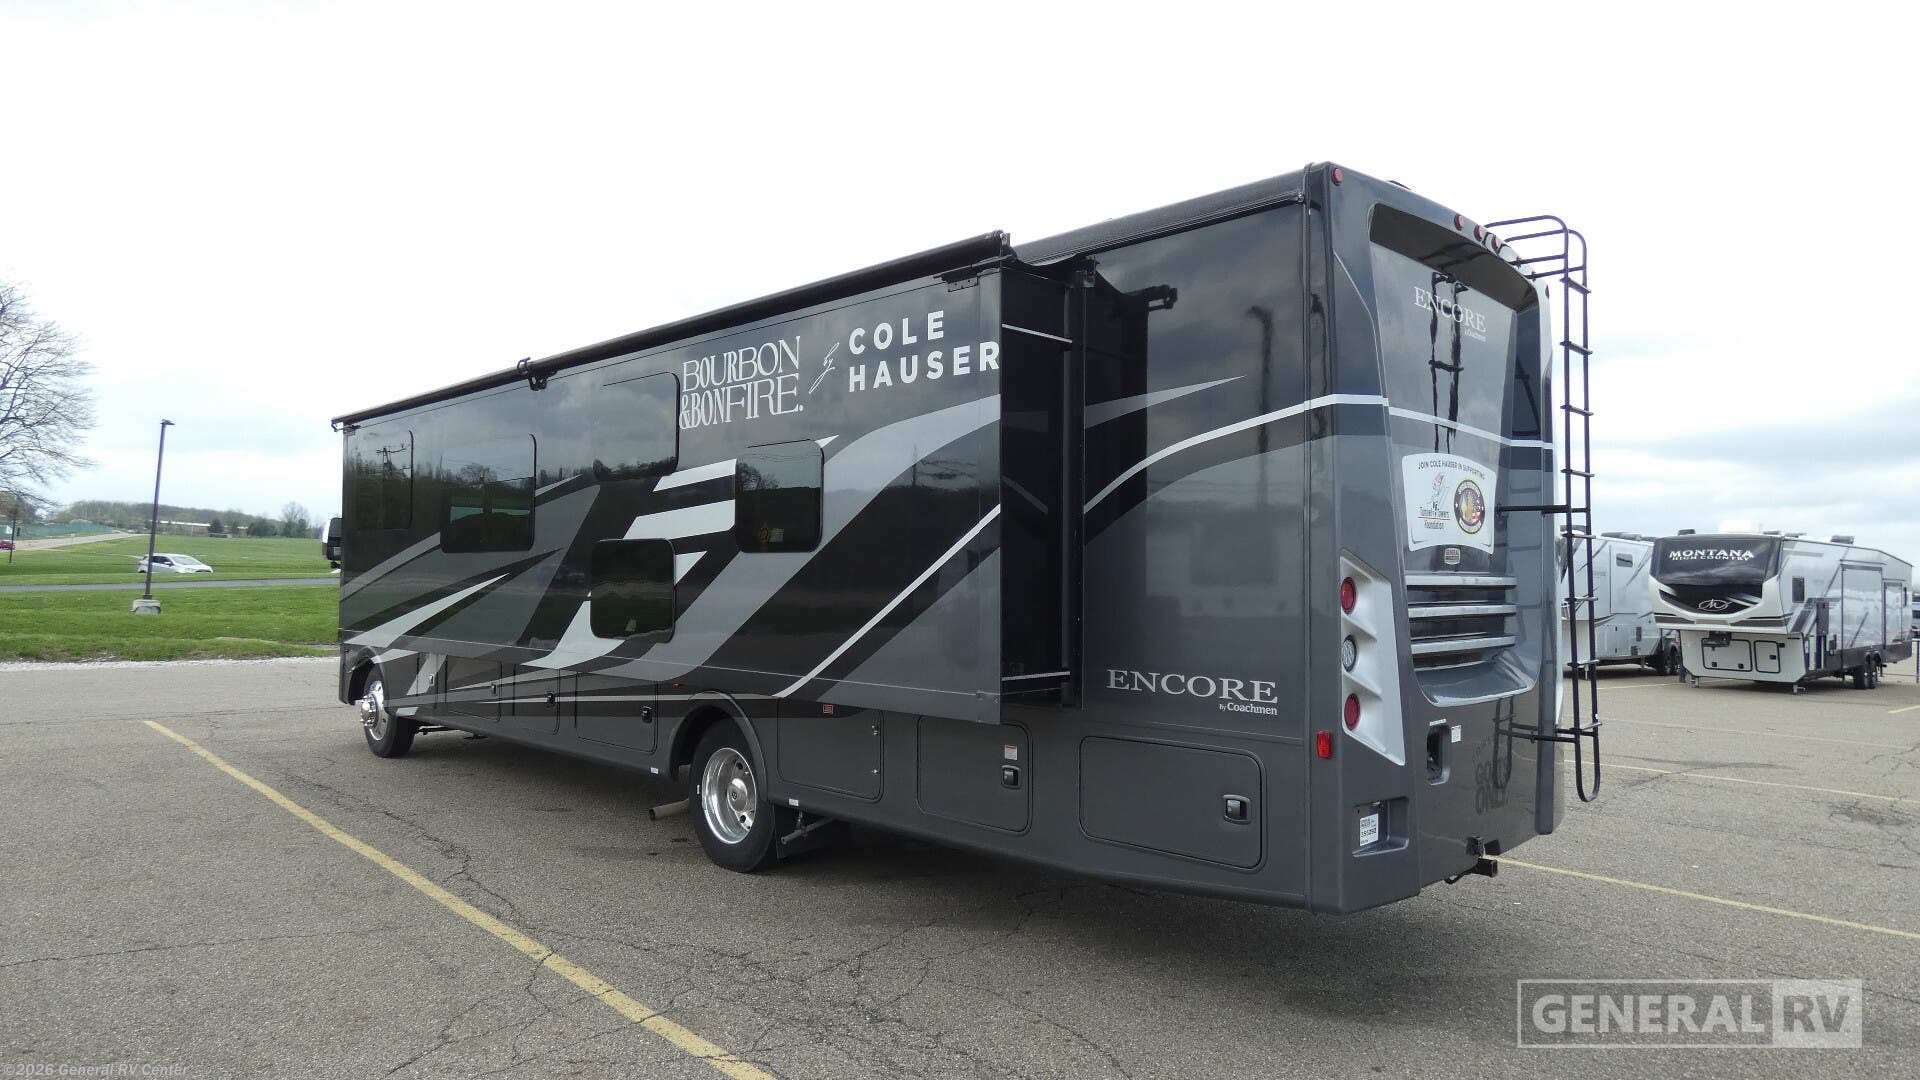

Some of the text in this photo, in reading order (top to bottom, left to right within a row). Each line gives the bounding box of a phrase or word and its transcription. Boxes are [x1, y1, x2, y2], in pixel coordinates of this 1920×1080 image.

[1414, 286, 1487, 333] ENCORE
[849, 310, 944, 355] COLE
[681, 336, 801, 393] BOURBON
[849, 341, 1000, 392] HAUSER
[1418, 461, 1429, 470] JOIN
[1430, 460, 1441, 468] COLE
[1669, 549, 1755, 559] MONTANA
[1107, 669, 1278, 703] ENCORE
[1227, 702, 1278, 715] Coachmen
